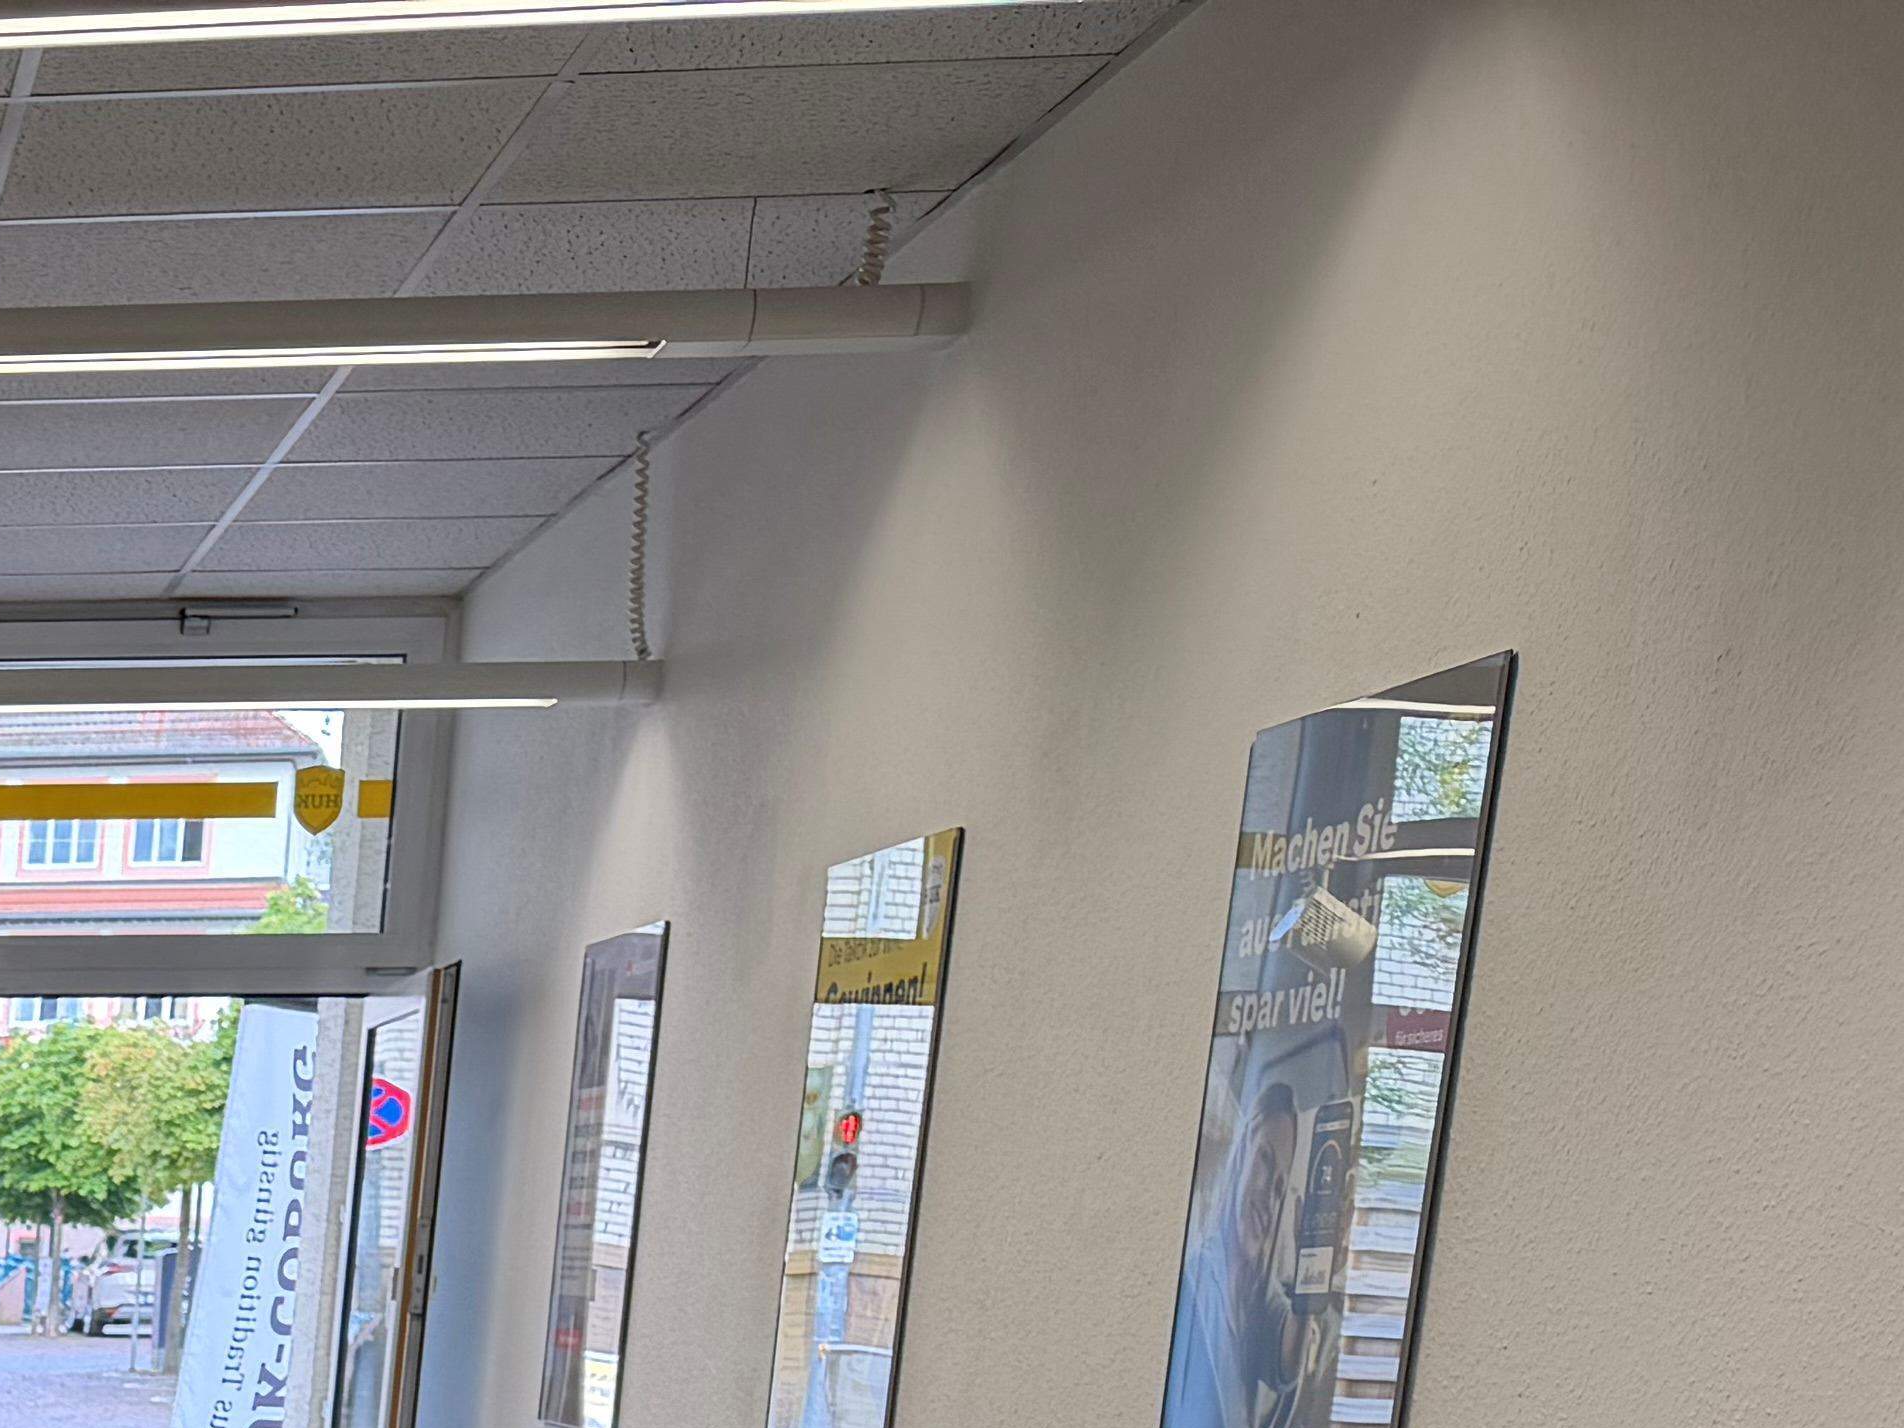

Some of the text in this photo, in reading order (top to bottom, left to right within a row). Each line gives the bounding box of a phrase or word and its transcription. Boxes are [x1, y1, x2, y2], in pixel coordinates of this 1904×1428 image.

[1250, 797, 1398, 881] Machen Sie
[1227, 967, 1346, 1046] spar viel!
